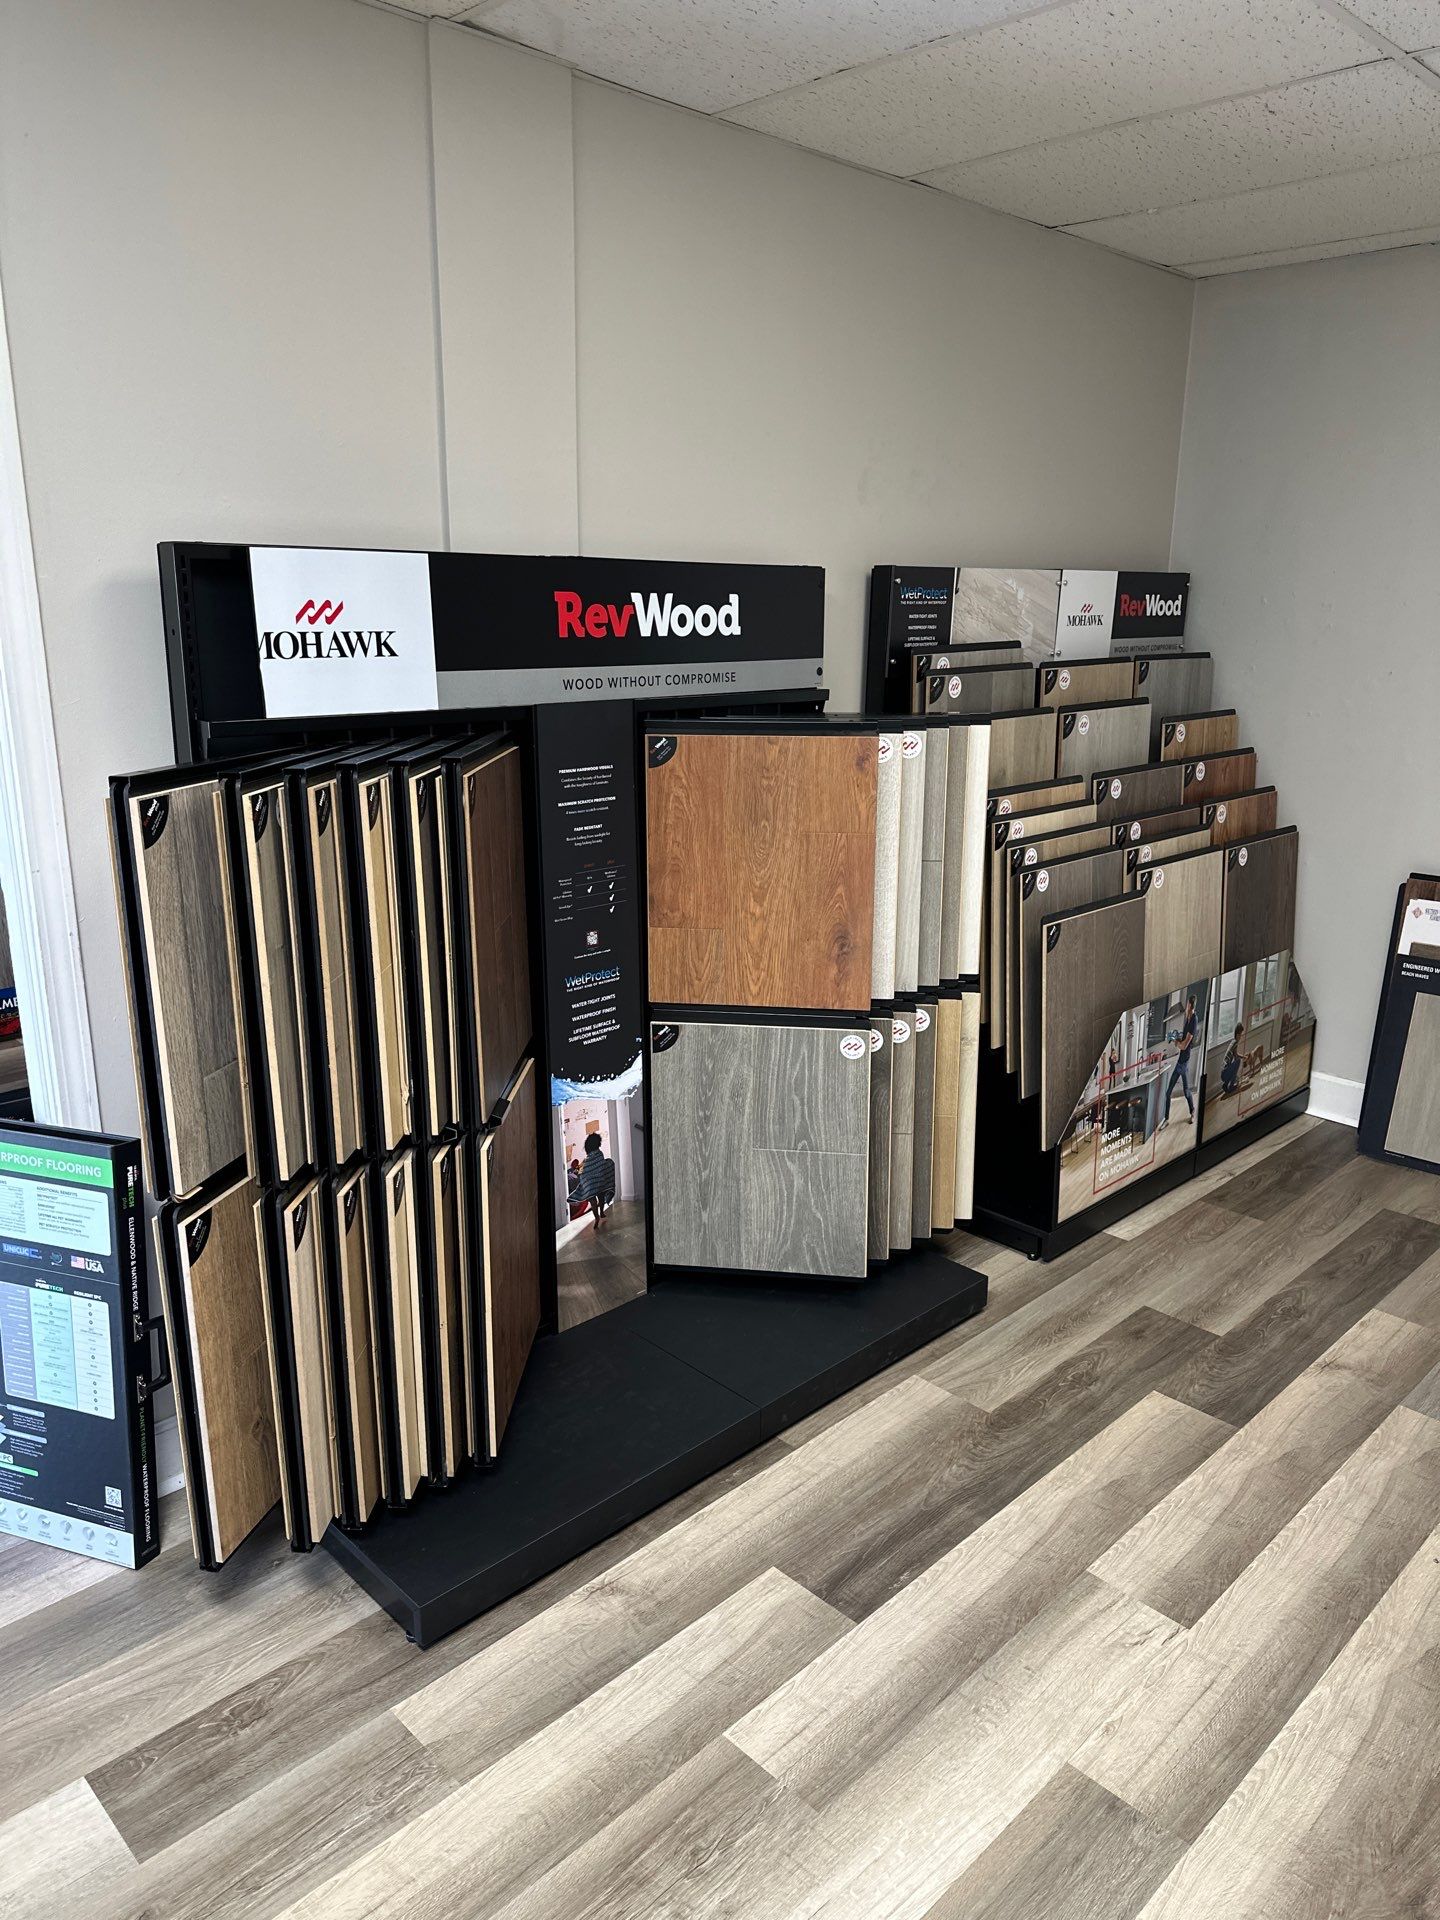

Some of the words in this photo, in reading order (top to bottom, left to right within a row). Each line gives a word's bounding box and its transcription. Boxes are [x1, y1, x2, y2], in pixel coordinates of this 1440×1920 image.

[900, 586, 948, 600] WetProtect
[554, 591, 742, 638] RevWood
[1119, 593, 1182, 617] RevWood
[1066, 614, 1104, 627] MOHAWK
[1130, 644, 1150, 652] WITHOUT
[563, 677, 604, 690] WOOD
[608, 675, 661, 689] WITHOUT
[665, 671, 737, 686] COMPROMISE
[564, 966, 620, 987] WetProtect
[1402, 962, 1434, 973] ENGINEERED
[600, 993, 616, 1001] JOINTS
[571, 1010, 602, 1022] WATERPROOF
[602, 1006, 617, 1014] FINISH
[568, 1032, 592, 1043] SUBFLOOR
[591, 1024, 621, 1036] WATERPROOF
[573, 1025, 593, 1035] LIFETIME
[592, 1021, 612, 1029] SURFACE
[582, 1034, 608, 1045] WARRANTY
[1271, 1046, 1285, 1059] MORE
[1260, 1057, 1284, 1075] MOMENTS
[1259, 1076, 1269, 1086] ARE
[1269, 1067, 1284, 1080] MADE
[1250, 1090, 1260, 1101] ON
[1260, 1078, 1282, 1097] MOHAWK
[1100, 1133, 1132, 1156] MOMENTS
[1101, 1127, 1121, 1143] MORE
[0, 1152, 44, 1168] RPROOF
[45, 1158, 102, 1178] FLOORING
[1100, 1155, 1114, 1169] ARE
[1113, 1145, 1132, 1162] MADE
[1098, 1169, 1110, 1182] ON
[1109, 1153, 1140, 1175] MOHAWK
[126, 1165, 136, 1208] PURETECH
[127, 1216, 136, 1260] ELLENWOOD
[85, 1261, 104, 1274] USA
[130, 1267, 138, 1290] NATIVE
[142, 1463, 151, 1508] WATERPROOF
[143, 1508, 152, 1543] FLOORING
